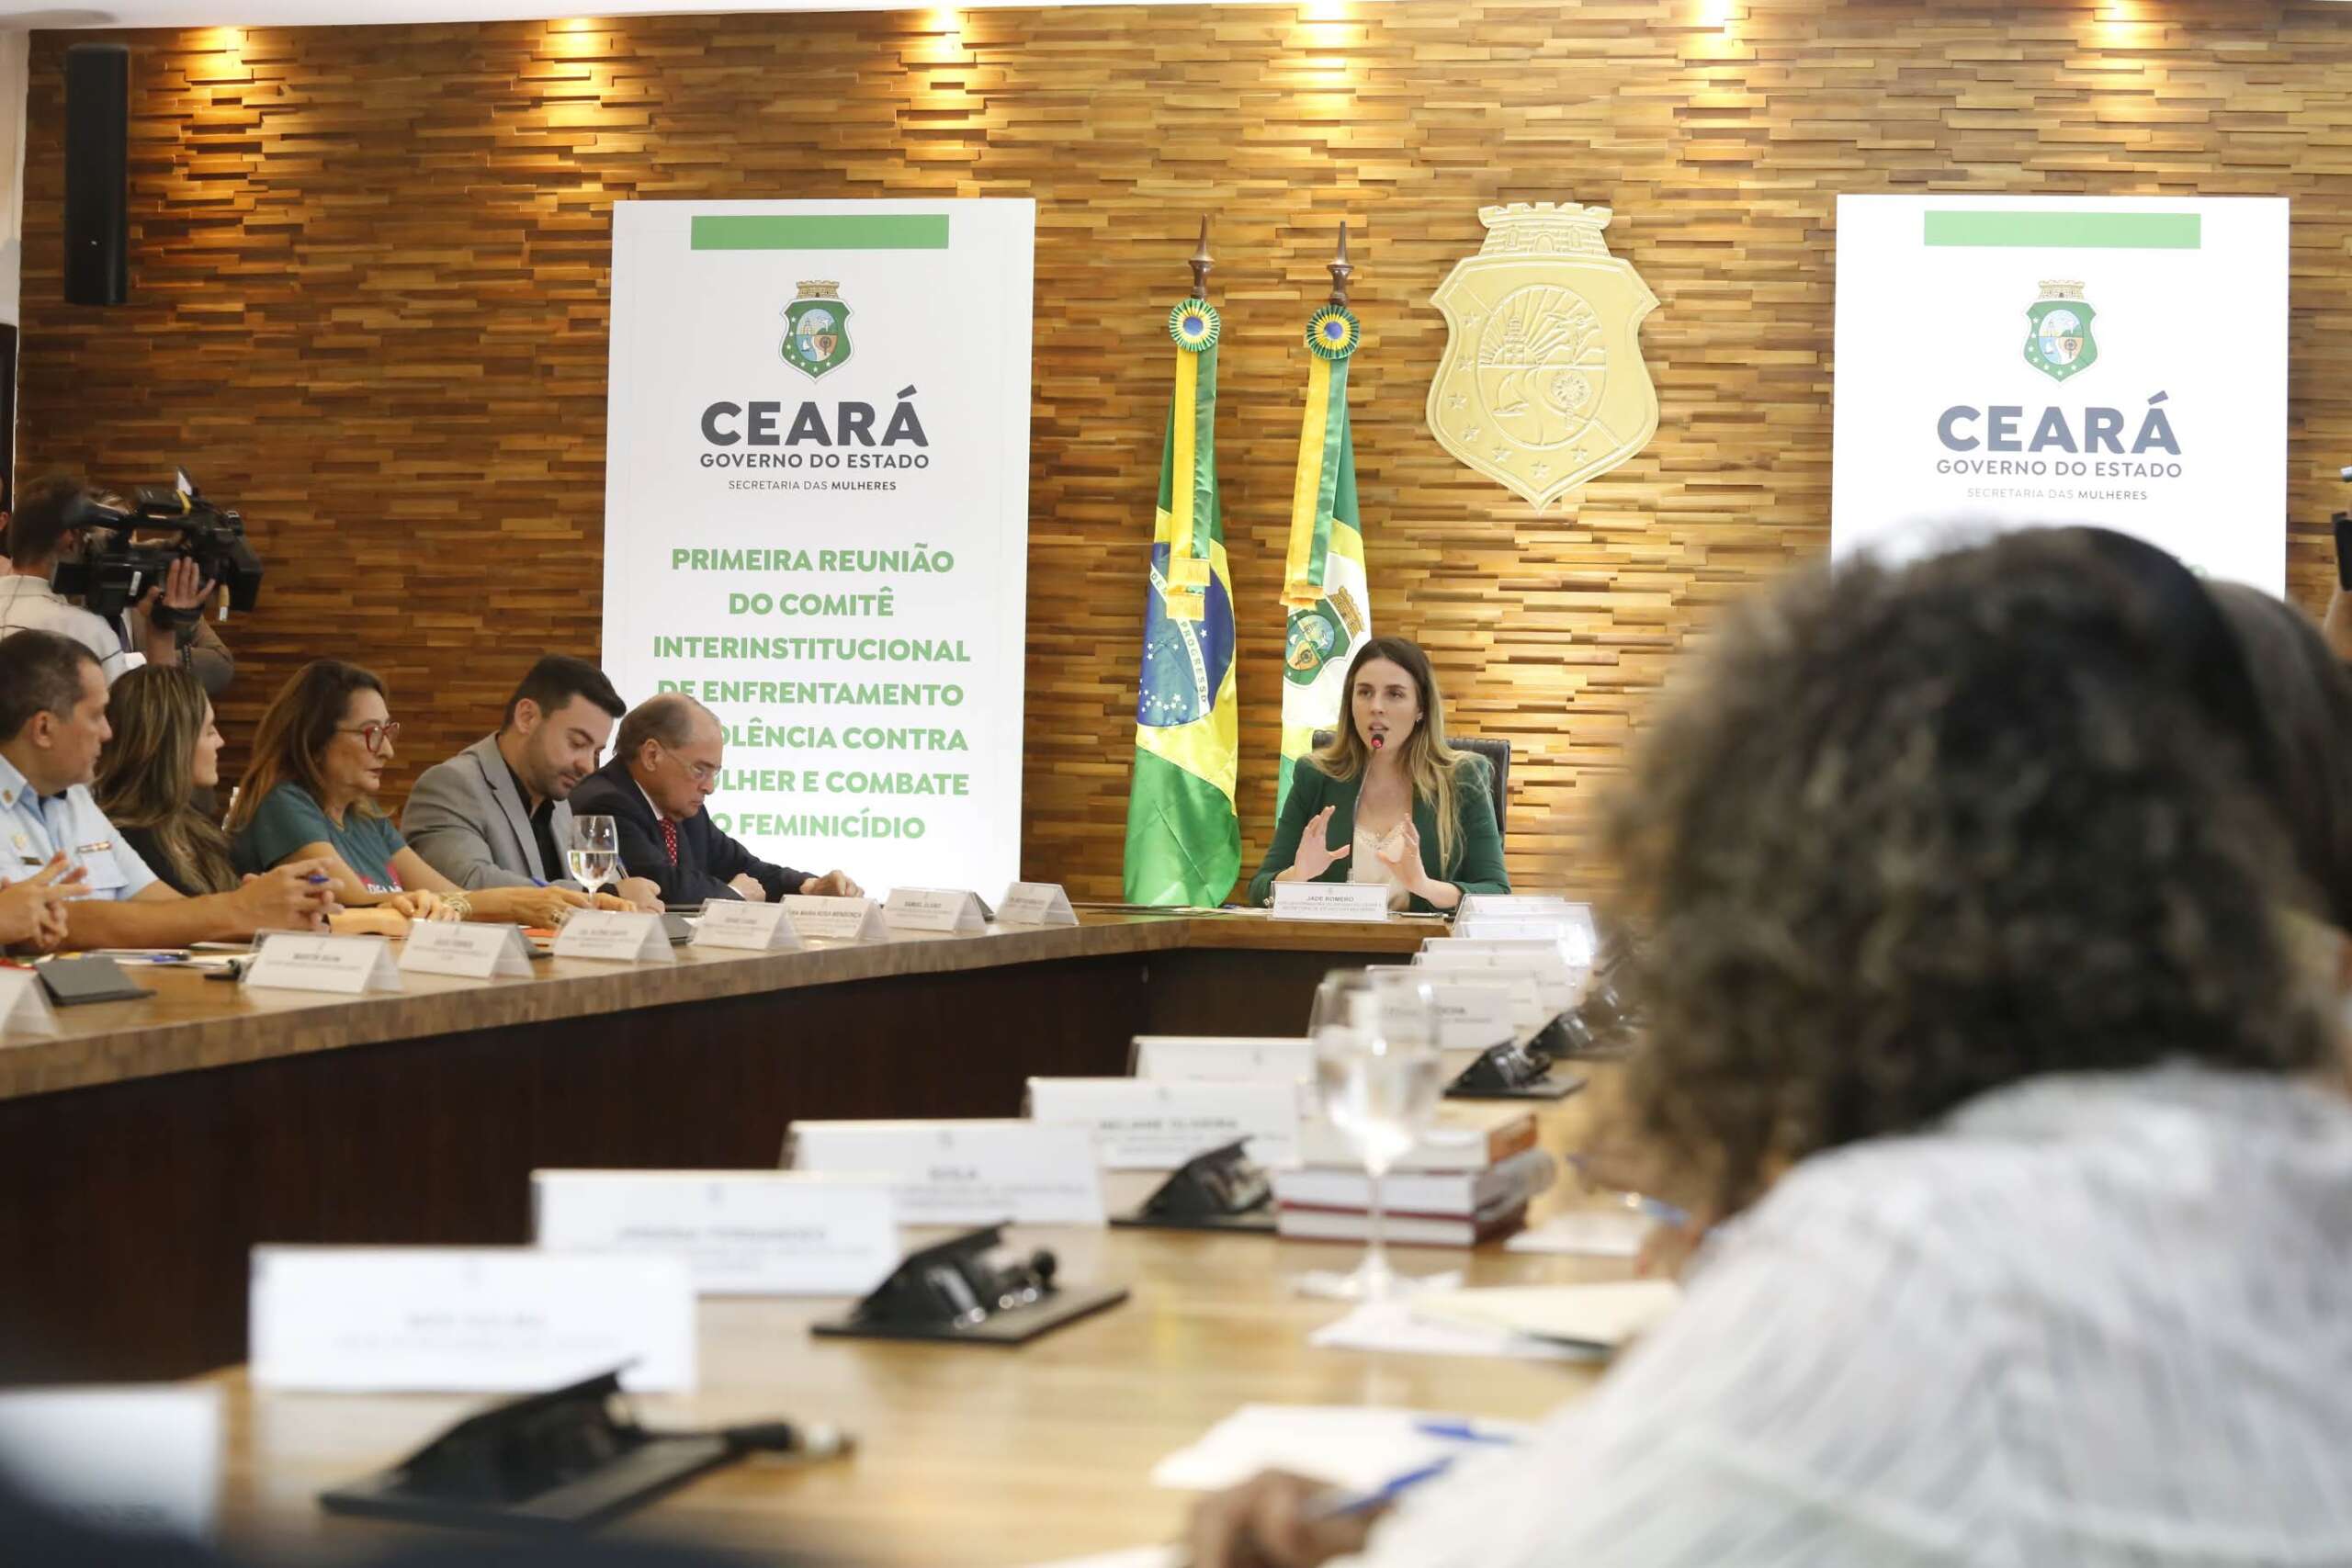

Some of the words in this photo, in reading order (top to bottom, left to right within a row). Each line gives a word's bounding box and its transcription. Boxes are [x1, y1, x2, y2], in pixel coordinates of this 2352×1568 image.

[701, 384, 929, 447] CEARÁ
[1937, 389, 2182, 456] CEARÁ
[700, 454, 803, 469] GOVERNO
[810, 454, 840, 469] DO
[848, 454, 929, 469] ESTADO
[1937, 459, 2046, 477] GOVERNO
[2056, 461, 2086, 477] DO
[2095, 462, 2182, 479] ESTADO
[729, 479, 801, 491] SECRETARIA
[804, 480, 828, 491] DAS
[831, 480, 897, 491] MULHERES
[1967, 488, 2044, 500] SECRETARIA
[2048, 489, 2075, 500] DAS
[2078, 490, 2148, 501] MULHERES
[672, 548, 814, 572] PRIMEIRA
[820, 542, 955, 573] REUNIÃO
[729, 593, 774, 615] DO
[779, 586, 895, 617] COMITÊ
[653, 636, 971, 662] INTERINSTITUCIONAL
[703, 680, 965, 706] ENFRENTAMENTO
[722, 716, 838, 749] LÊNCIA
[842, 727, 969, 751] CONTRA
[715, 769, 796, 793] LHER
[803, 770, 819, 793] E
[825, 771, 970, 796] COMBATE
[711, 813, 732, 833] O
[740, 808, 926, 840] FEMINICÍDIO
